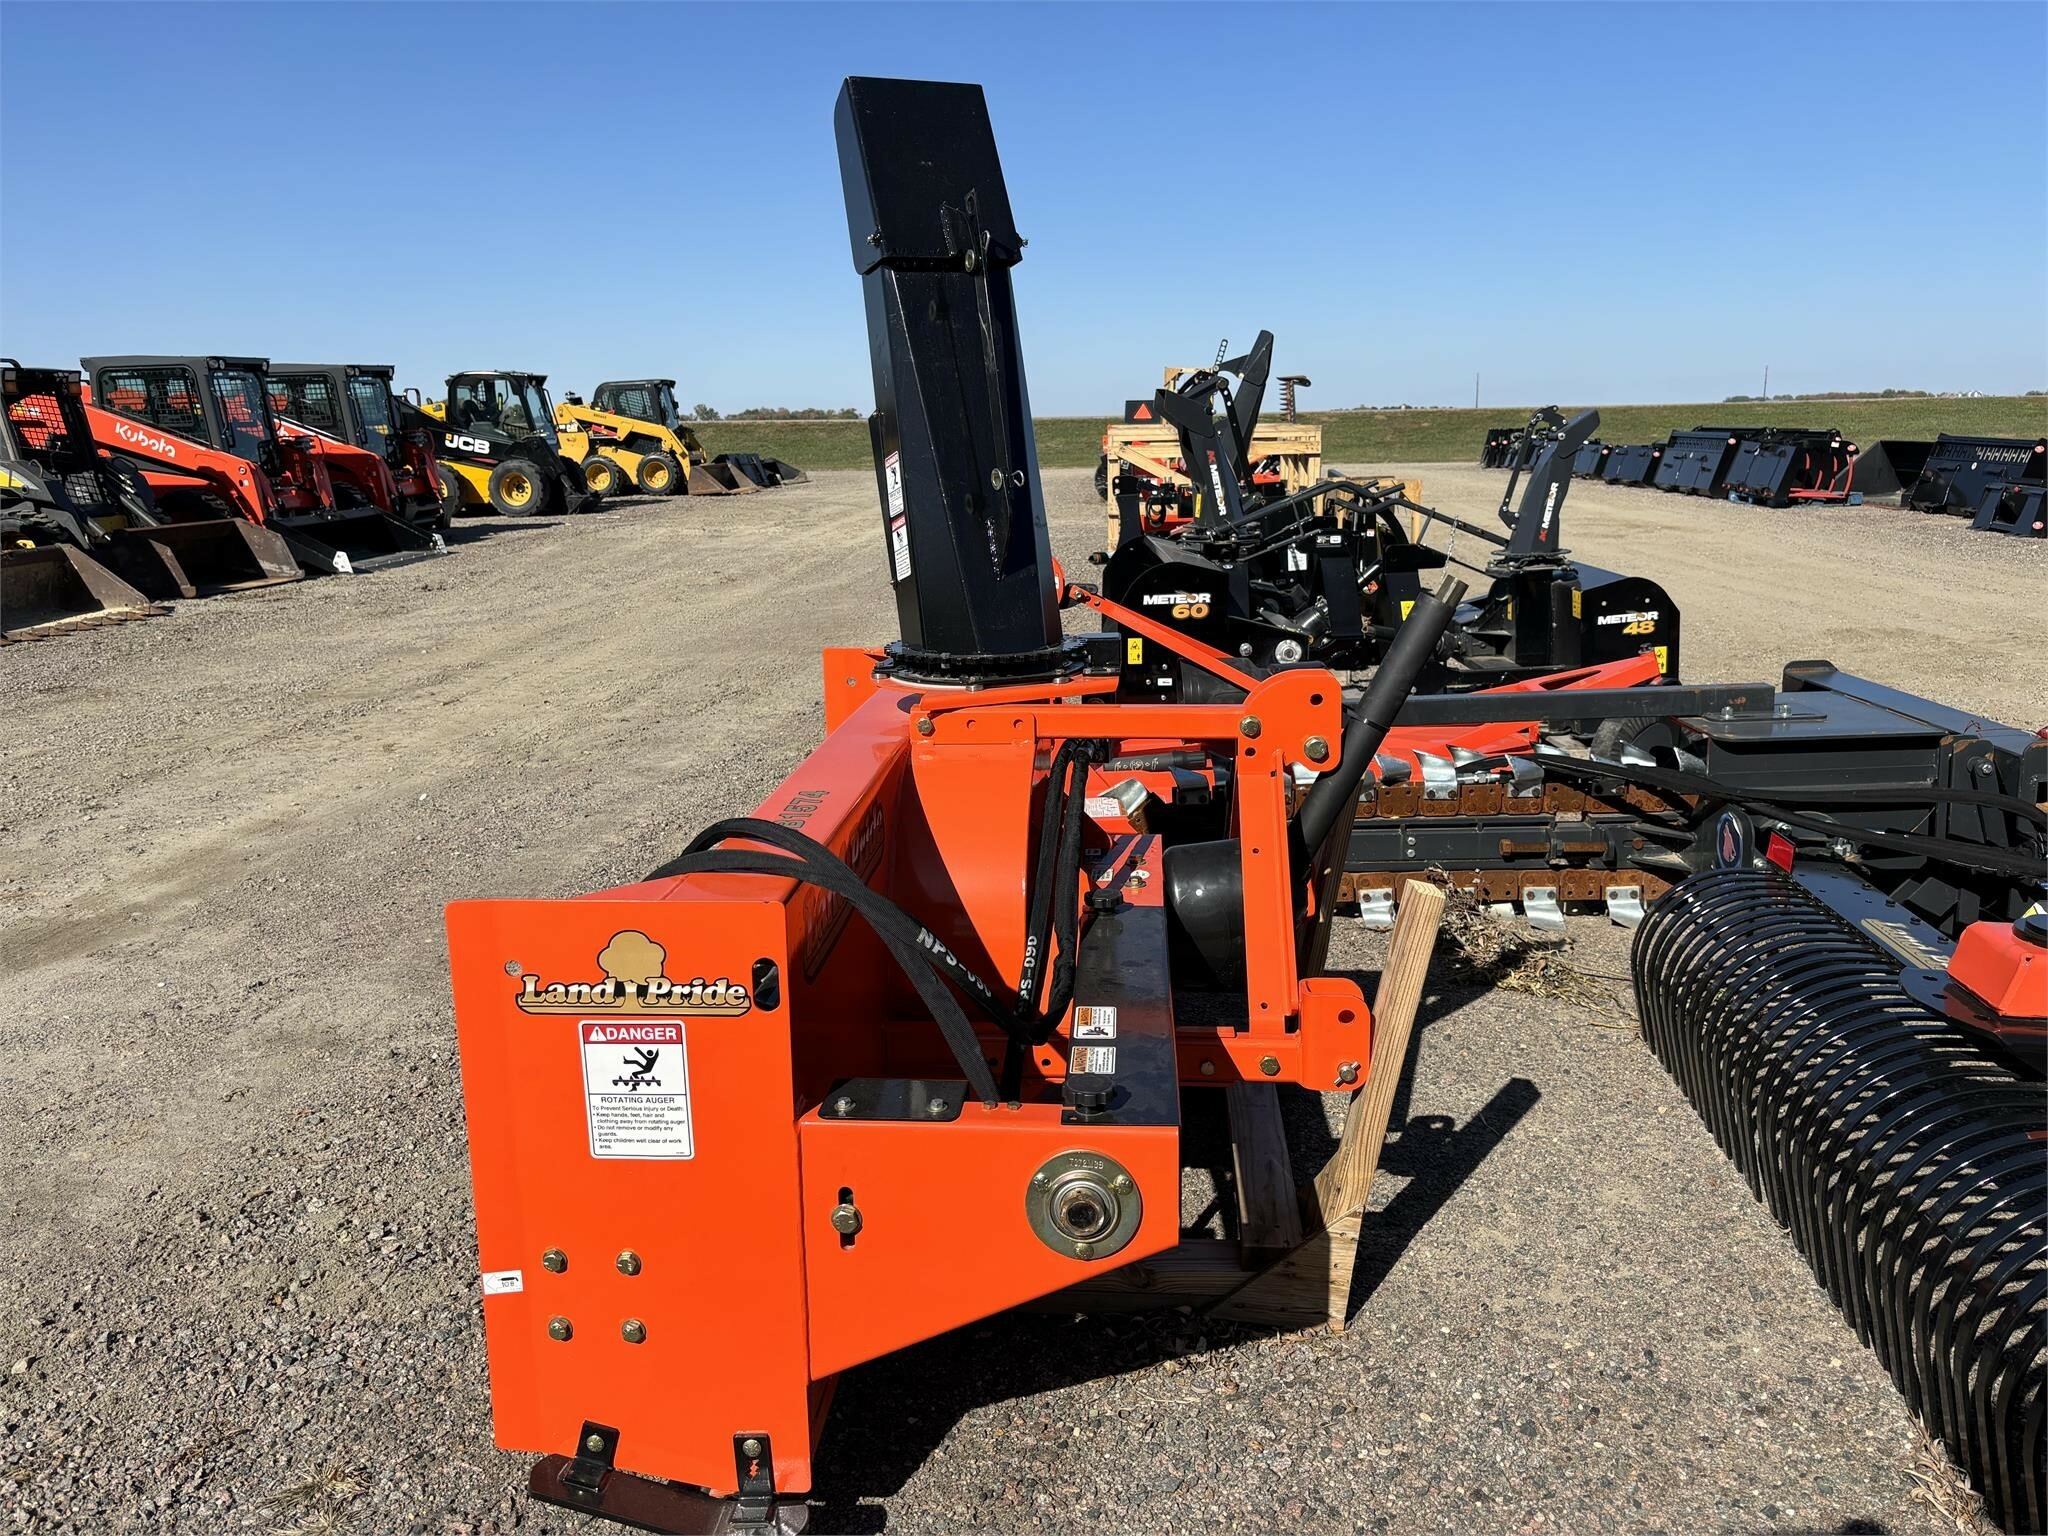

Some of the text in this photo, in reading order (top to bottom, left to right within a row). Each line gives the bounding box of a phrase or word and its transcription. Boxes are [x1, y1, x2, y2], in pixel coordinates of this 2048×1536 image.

[115, 422, 176, 458] Kubota
[445, 433, 490, 454] JCB
[1209, 464, 1227, 516] METEOR
[1541, 482, 1559, 529] METEOR
[1143, 592, 1211, 605] METEOR
[1172, 603, 1209, 619] 60
[1597, 611, 1659, 625] METEOR
[1622, 620, 1655, 635] 48
[521, 975, 745, 1006] Land Pride
[606, 1027, 677, 1041] DANGER
[600, 1096, 675, 1104] ROTATING AUGER
